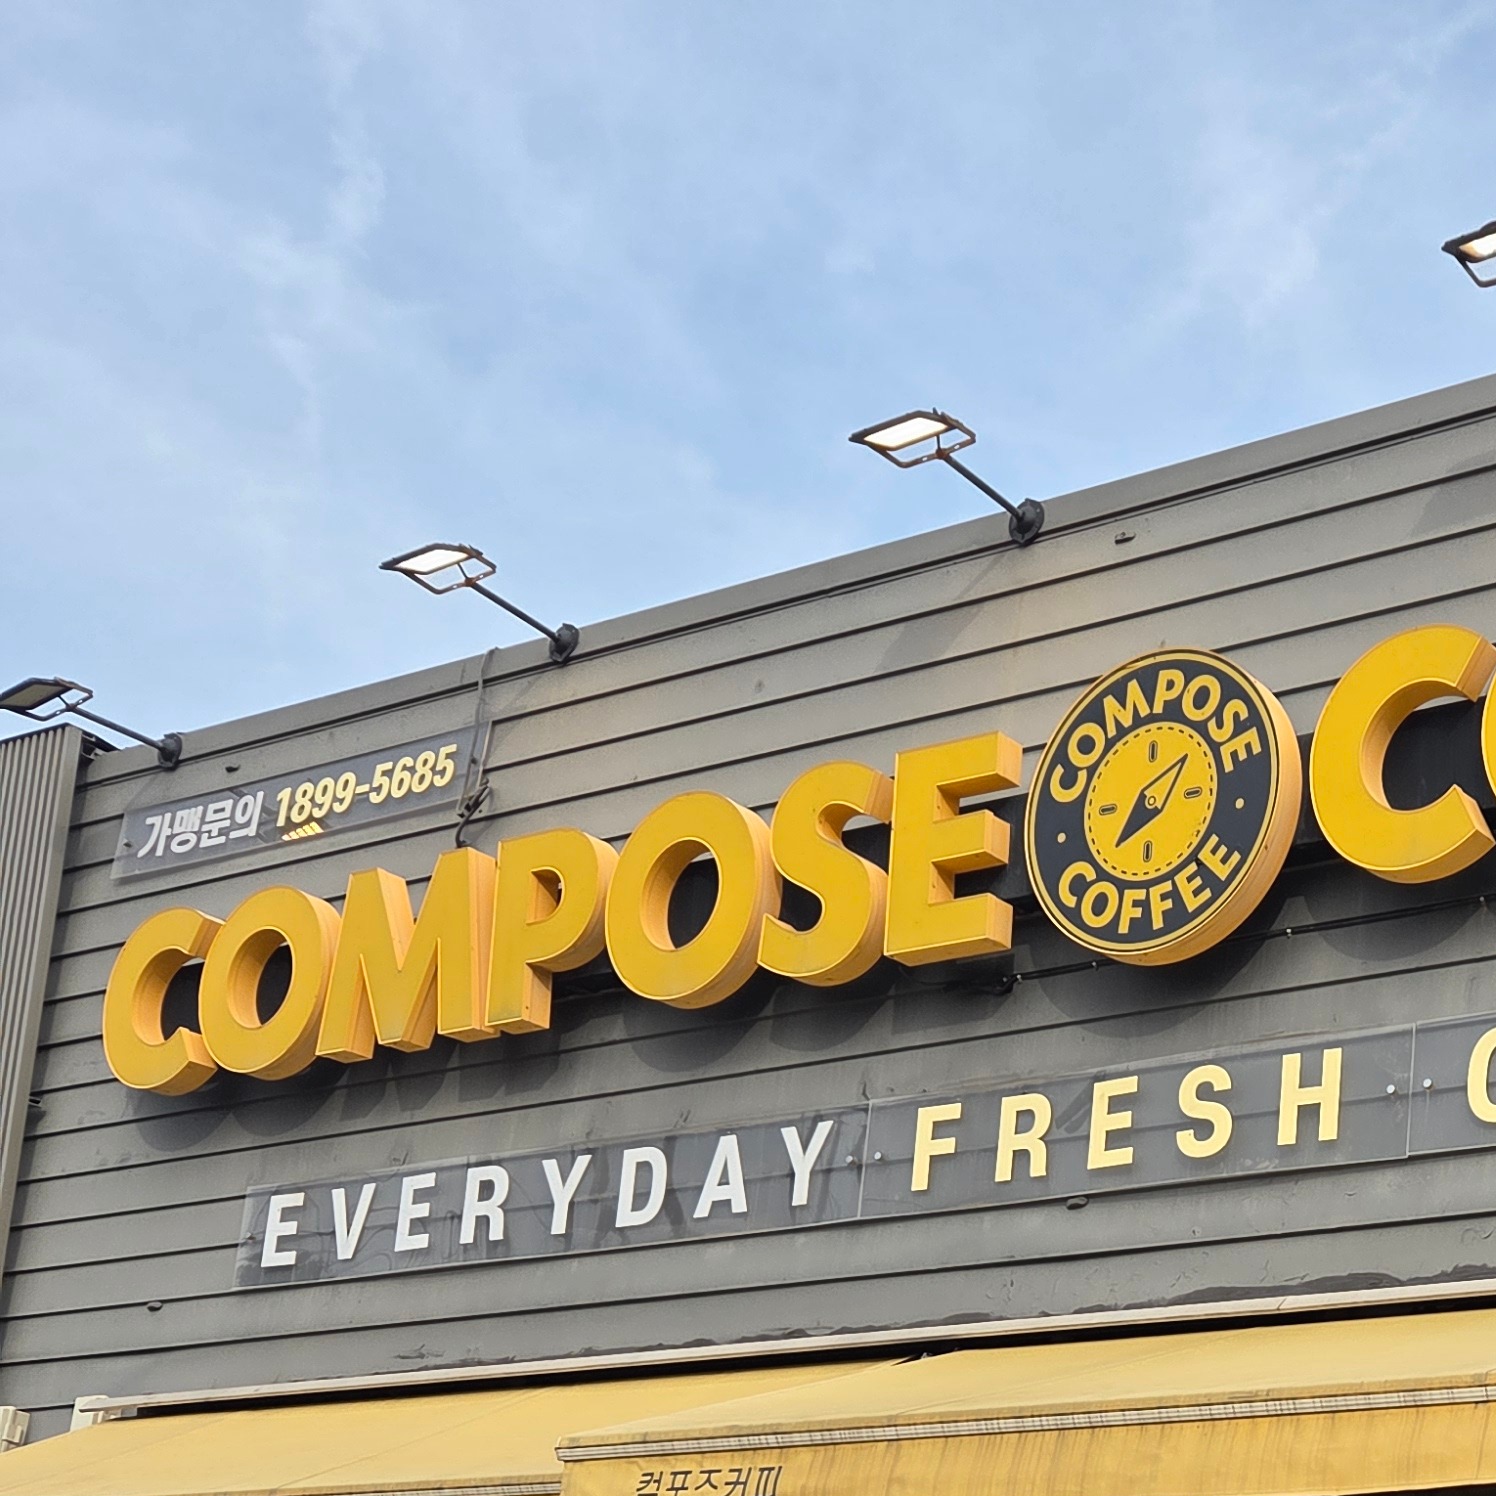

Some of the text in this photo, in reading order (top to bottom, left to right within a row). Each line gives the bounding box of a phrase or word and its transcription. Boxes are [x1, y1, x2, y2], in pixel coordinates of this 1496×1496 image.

[137, 743, 457, 860] 가맹문의 1899-5685
[1050, 668, 1262, 805] COMPOSE
[103, 731, 1024, 1096] COMPOSE
[1058, 833, 1242, 936] COFFEE
[260, 1121, 835, 1268] EVERYDAY
[911, 1047, 1343, 1193] FRESH
